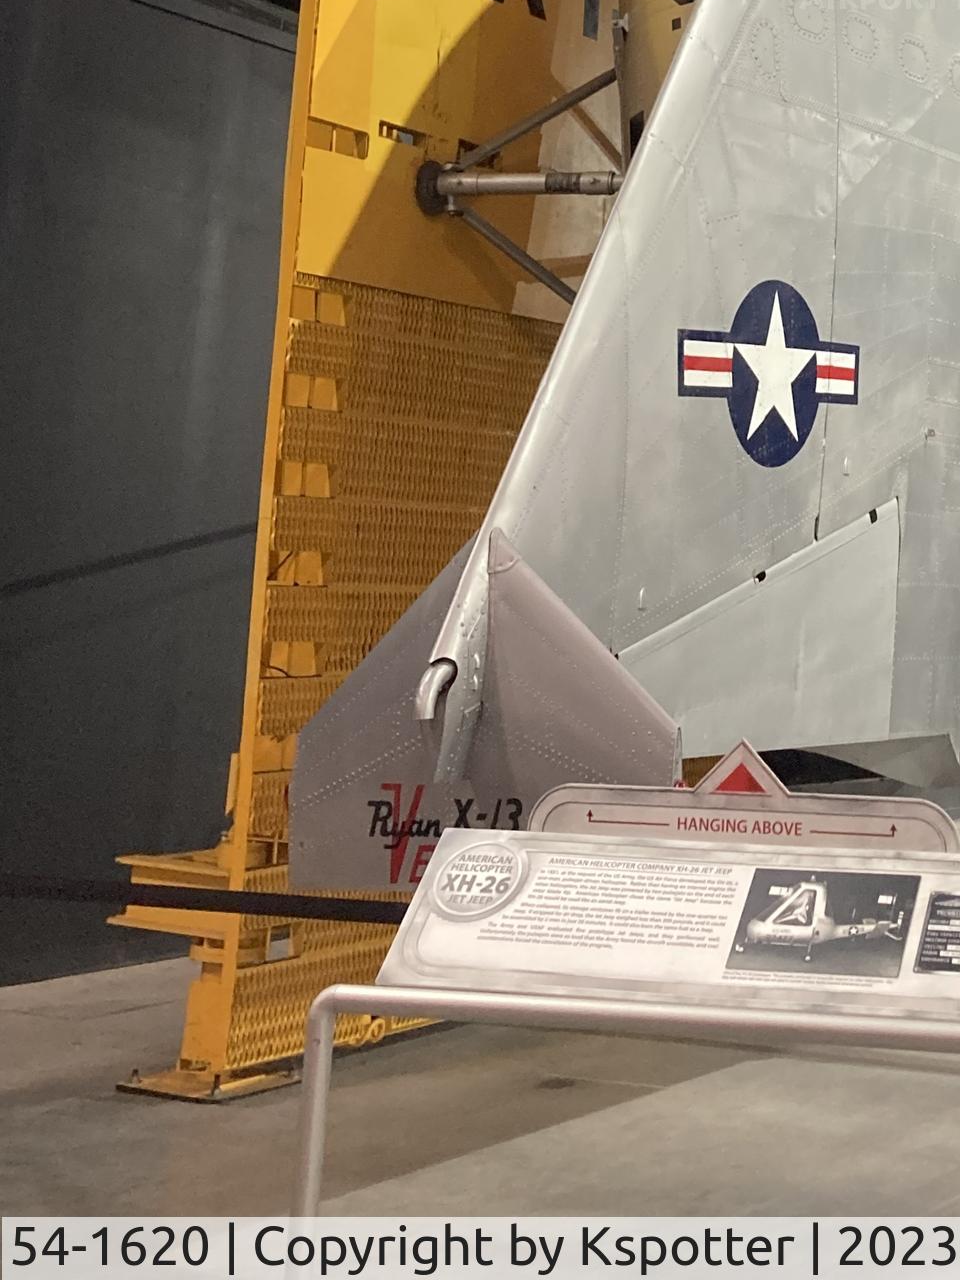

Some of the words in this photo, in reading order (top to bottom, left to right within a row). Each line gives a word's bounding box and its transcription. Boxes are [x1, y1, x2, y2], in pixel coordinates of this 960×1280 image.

[367, 800, 442, 849] Ryan
[453, 798, 523, 830] X-13
[677, 816, 748, 834] HANGING
[751, 820, 803, 836] ABOVE
[450, 862, 513, 874] HELICOPTER
[458, 854, 513, 865] AMERICAN
[548, 858, 589, 866] AMERICAN
[589, 859, 635, 869] HELICOPTER
[636, 863, 675, 872] COMPANY
[714, 867, 733, 875] JEEP
[440, 873, 511, 894] XH-26
[447, 894, 467, 904] JET
[467, 895, 493, 905] JEEP
